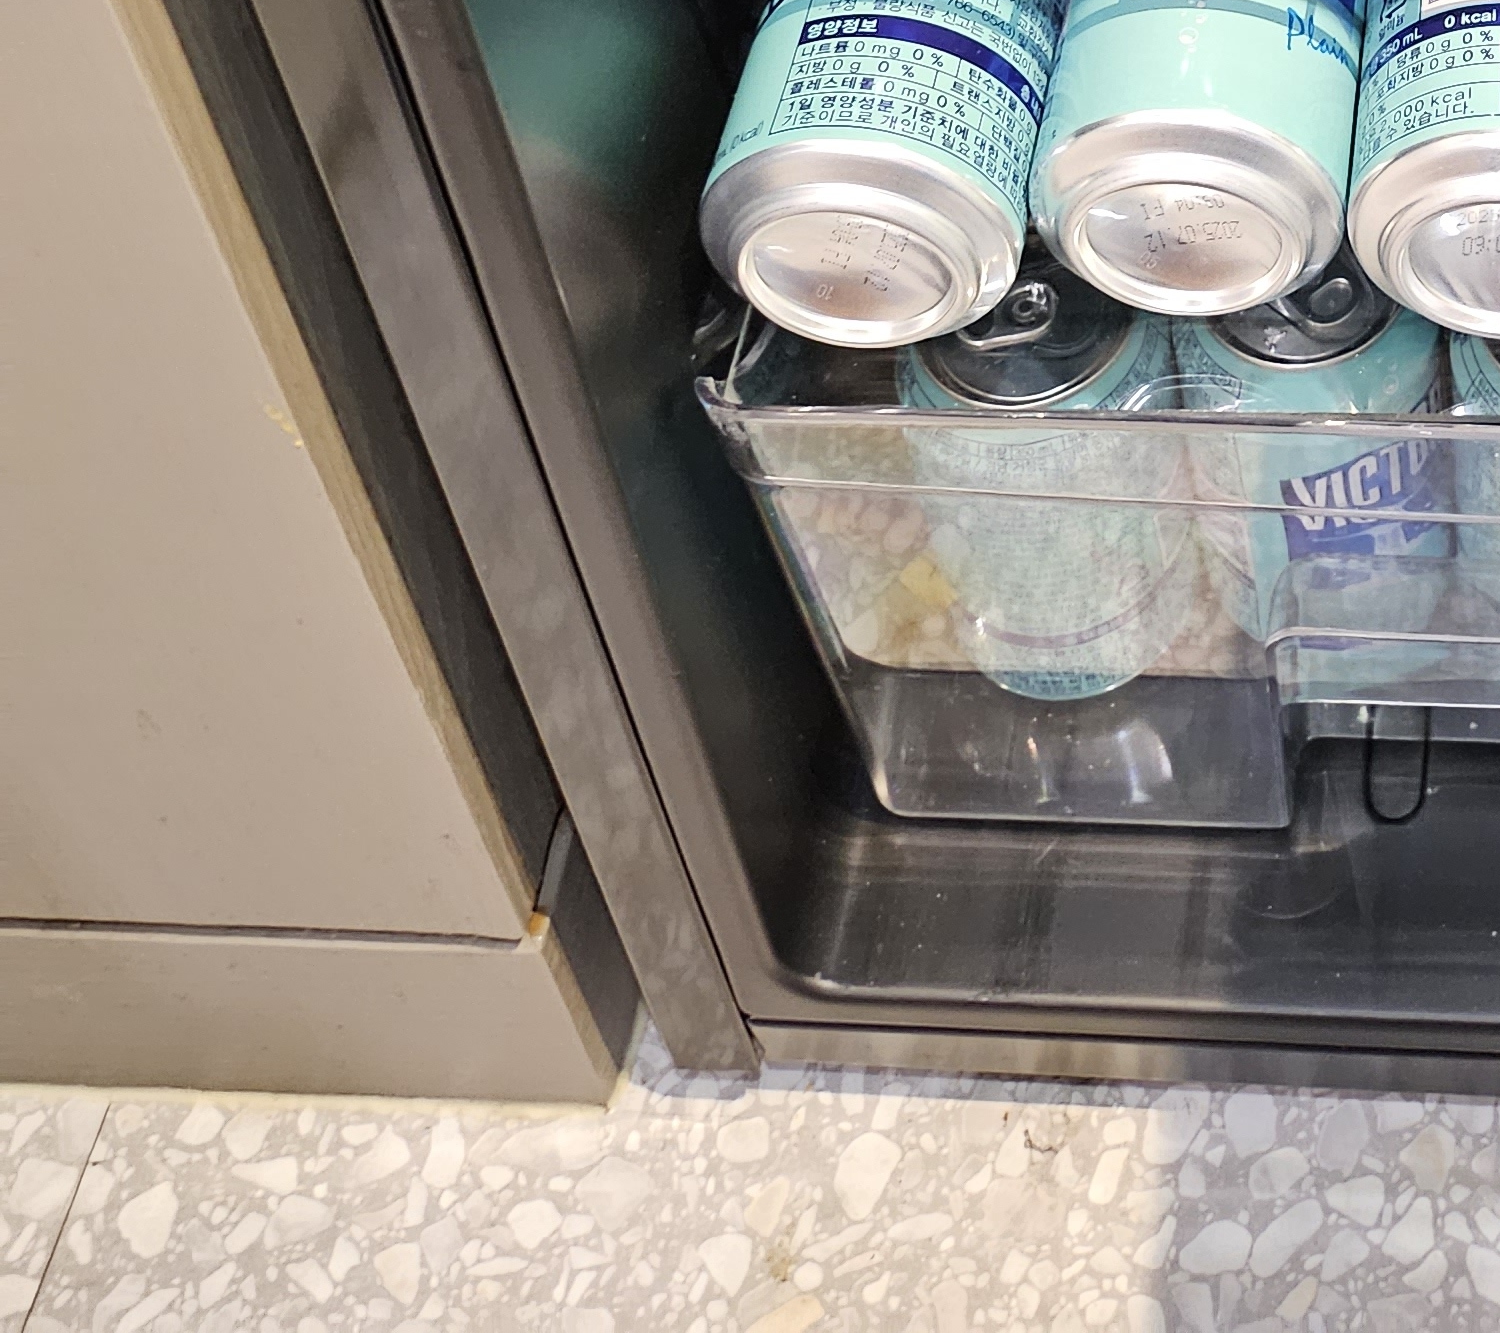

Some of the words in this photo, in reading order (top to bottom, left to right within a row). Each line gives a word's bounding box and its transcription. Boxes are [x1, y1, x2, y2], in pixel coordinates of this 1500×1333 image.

[807, 17, 878, 38] 영양정보
[1402, 27, 1423, 51] mL
[1460, 9, 1497, 26] kcal
[801, 40, 850, 58] 나트륨
[794, 61, 828, 76] 지방
[790, 76, 876, 95] 콜레스테롤
[1430, 86, 1472, 108] kcal
[781, 108, 873, 127] 기준이므로
[881, 115, 934, 142] 개인의
[787, 96, 814, 112] 1일
[820, 95, 895, 113] 영양성분
[901, 103, 969, 142] 기준치에
[973, 134, 999, 163] 대한
